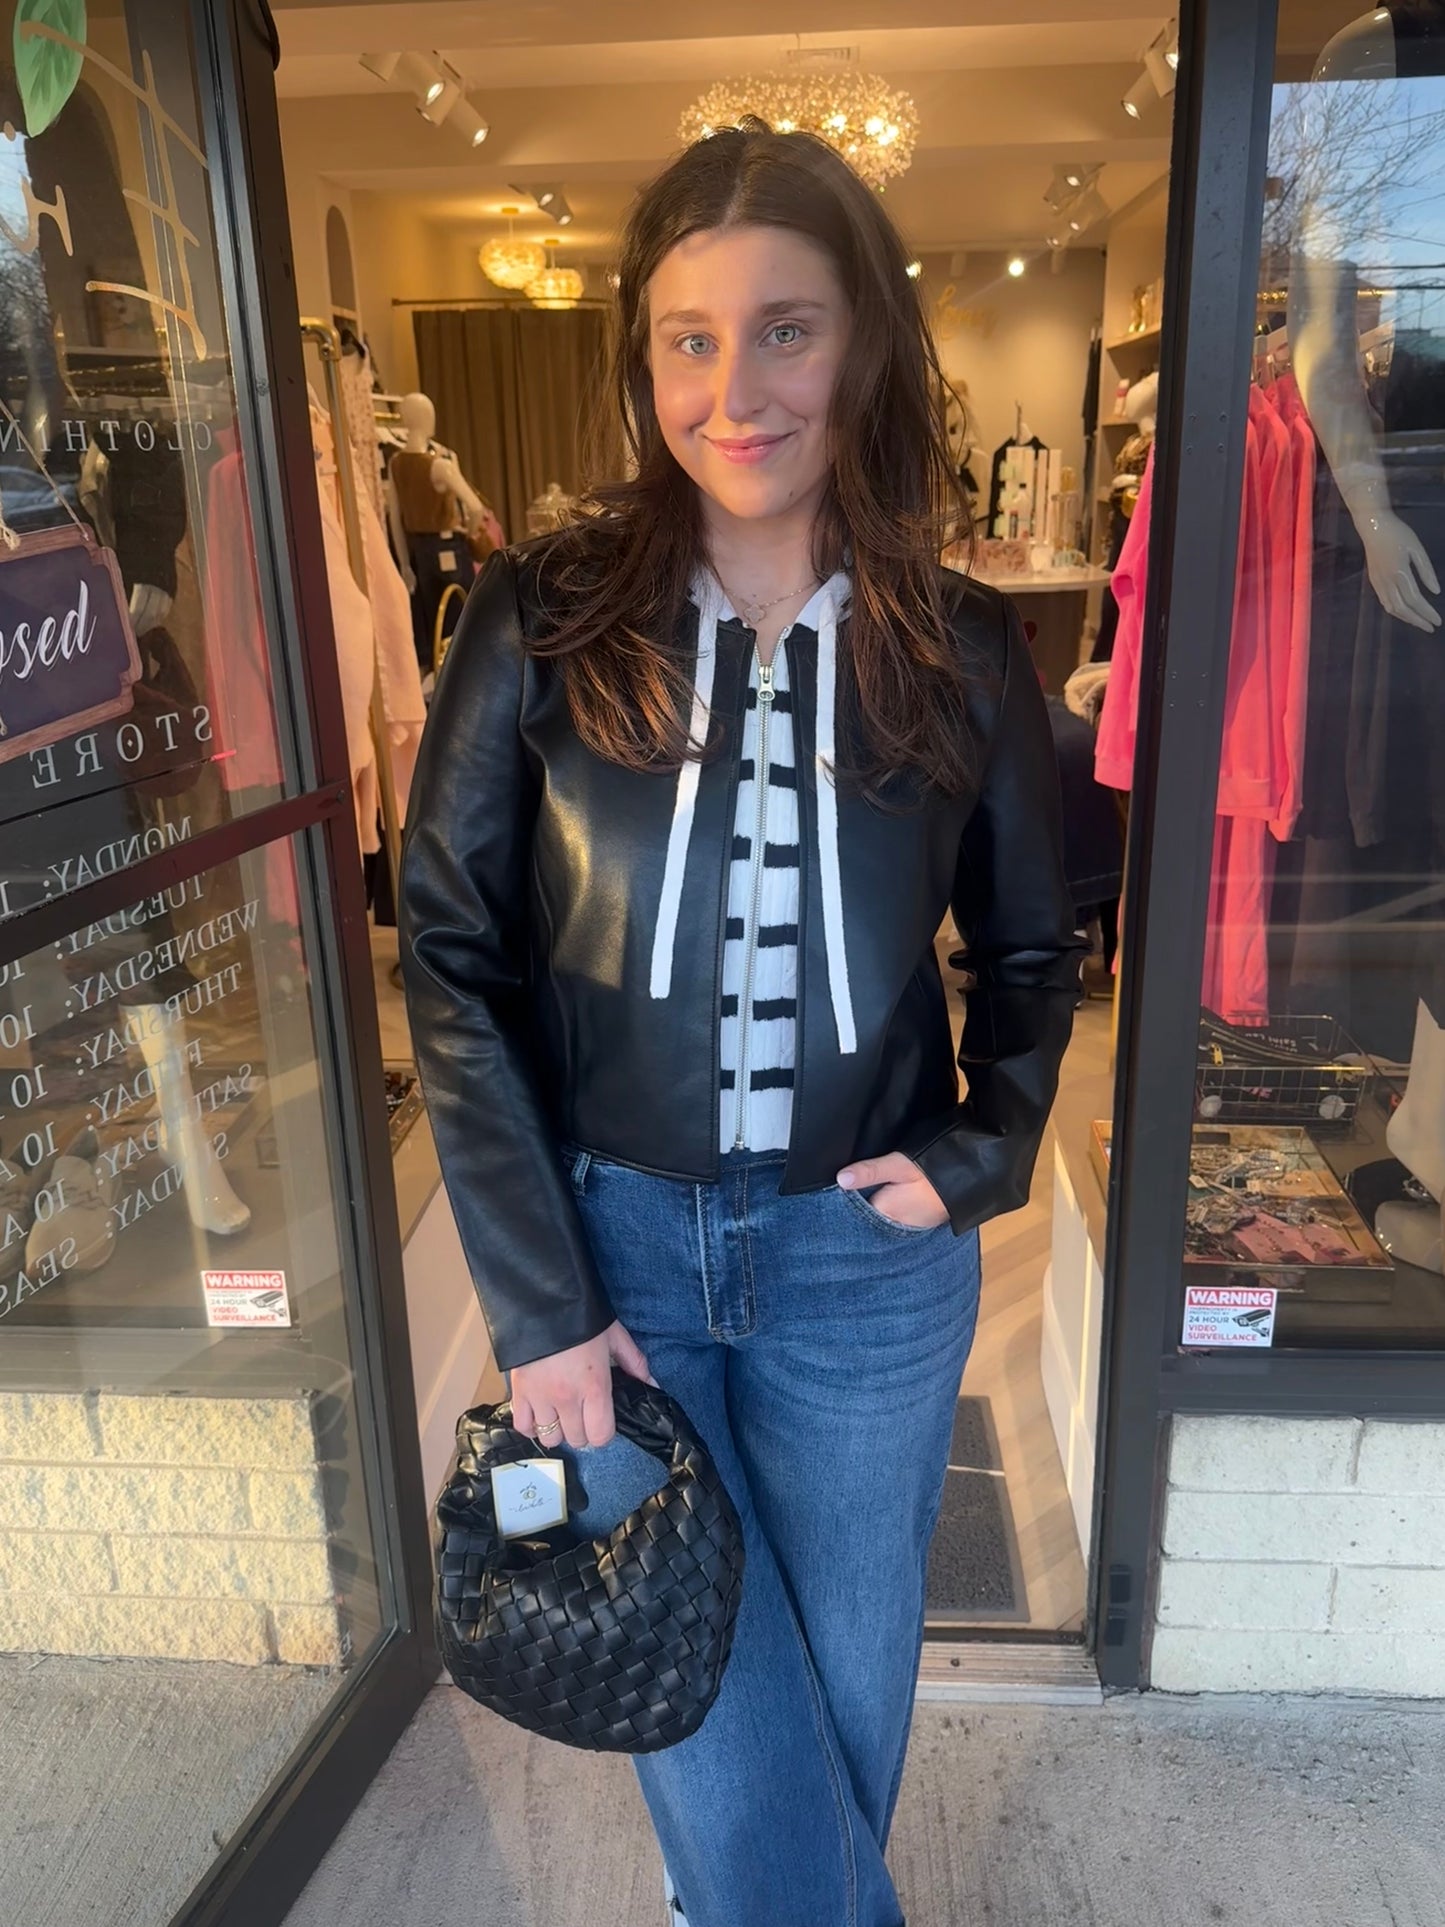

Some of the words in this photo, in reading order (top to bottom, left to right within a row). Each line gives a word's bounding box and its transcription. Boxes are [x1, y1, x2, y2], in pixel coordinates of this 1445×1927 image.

[207, 1274, 281, 1287] WARNING
[1190, 1291, 1272, 1305] WARNING
[1187, 1332, 1257, 1341] SURVEILLANCE
